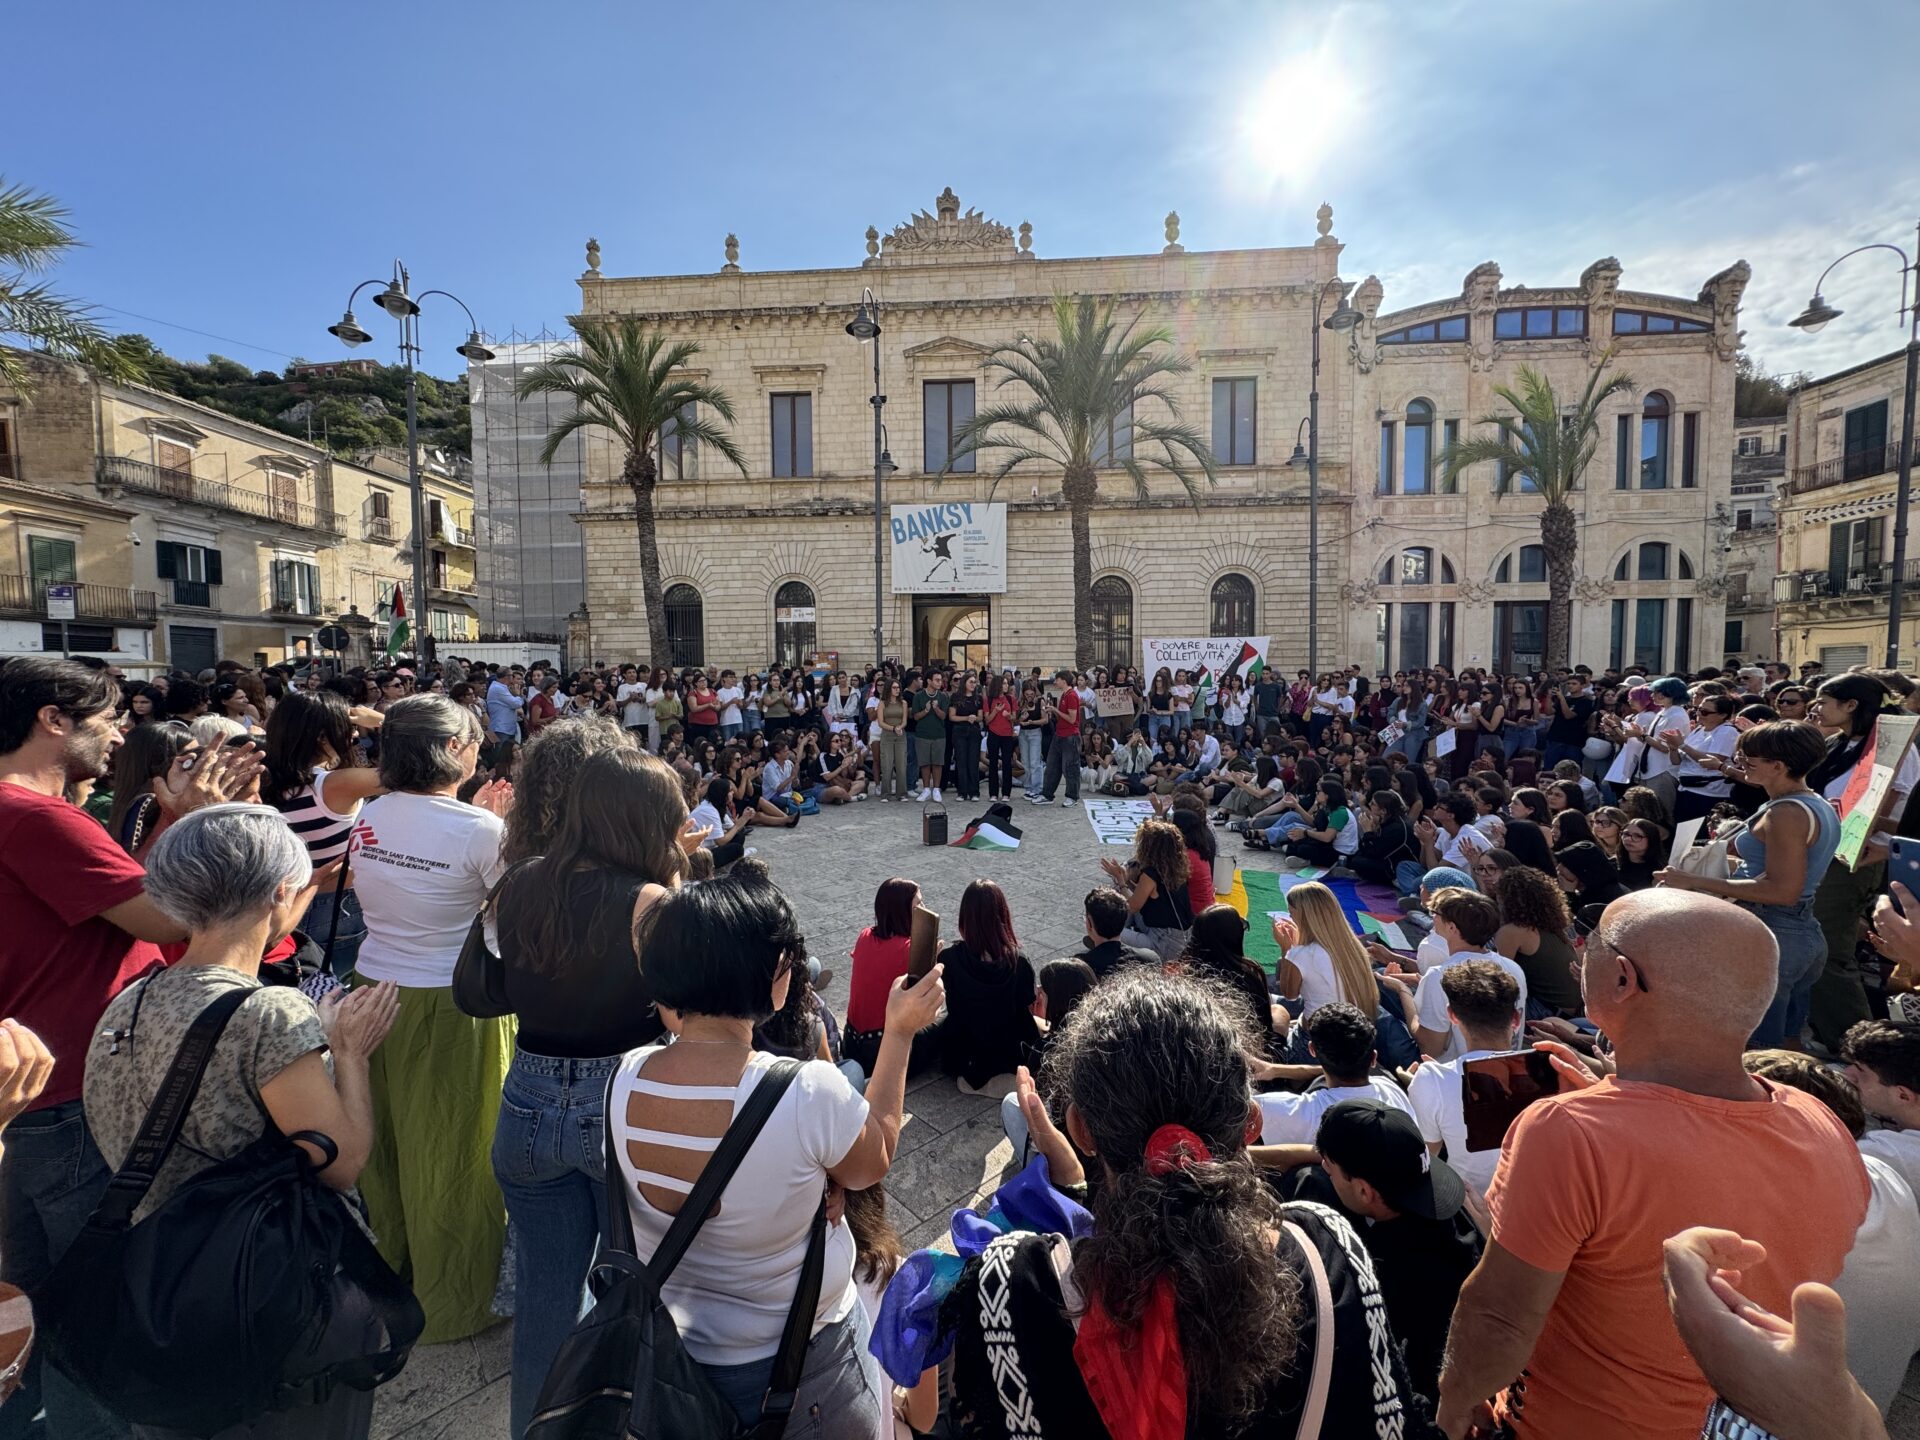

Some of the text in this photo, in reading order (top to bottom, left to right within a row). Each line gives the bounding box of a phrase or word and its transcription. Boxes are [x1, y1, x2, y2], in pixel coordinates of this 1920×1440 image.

[891, 503, 973, 545] BANKSY
[1162, 641, 1200, 650] DOVERE
[1206, 642, 1230, 650] DELLA
[1155, 649, 1225, 661] COLLETTIVITÀ
[389, 851, 404, 860] SANS
[378, 856, 395, 865] UDEN
